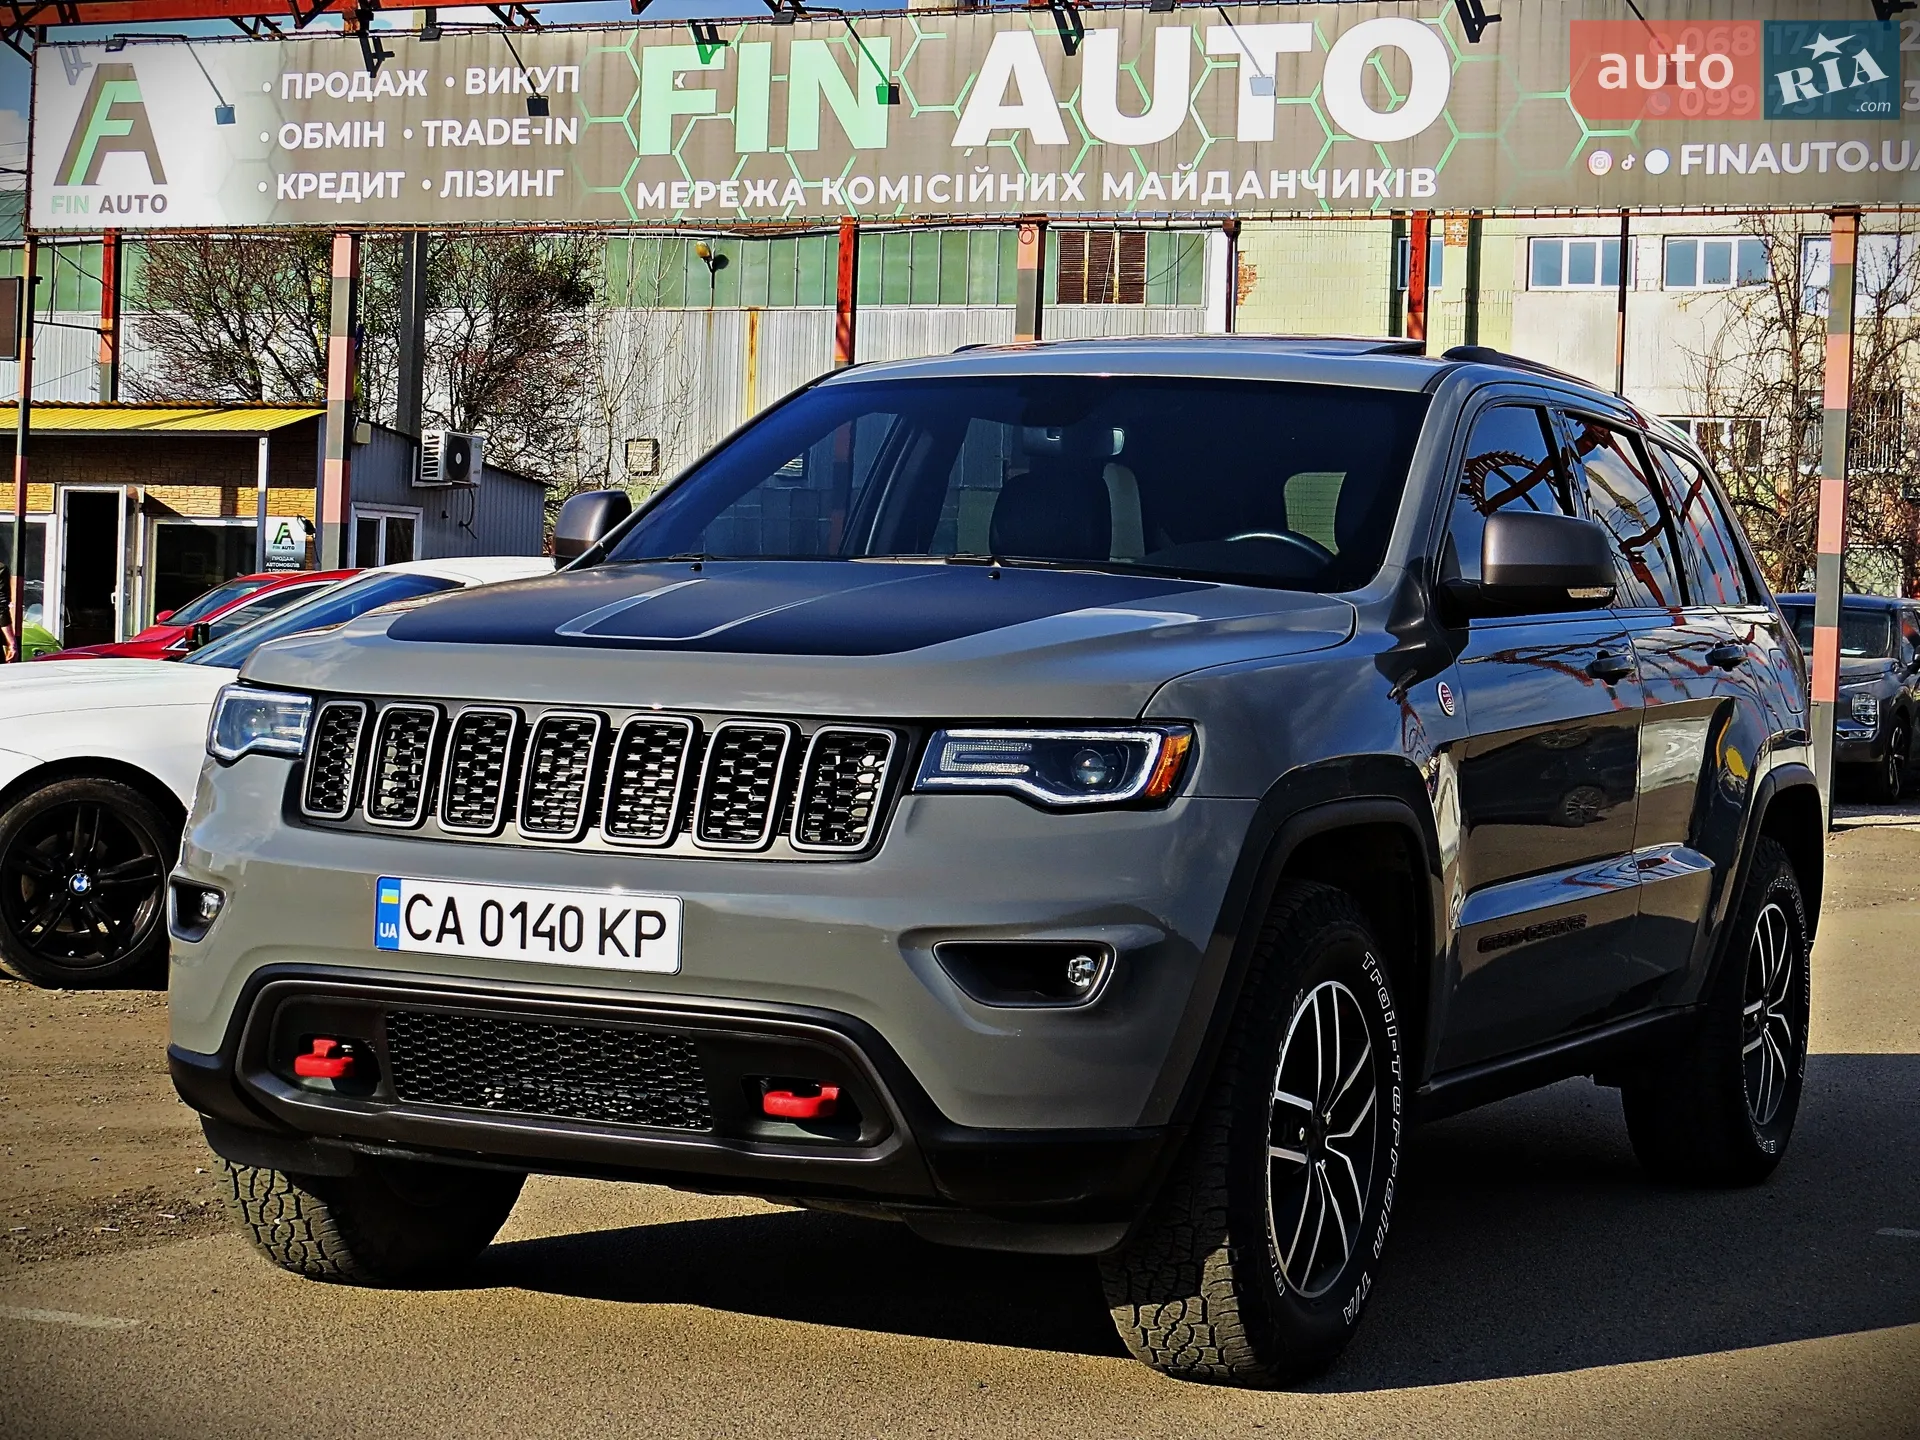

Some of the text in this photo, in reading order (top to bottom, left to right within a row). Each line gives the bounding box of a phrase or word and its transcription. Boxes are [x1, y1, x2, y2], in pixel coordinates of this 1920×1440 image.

[281, 69, 429, 103] ПРОДАЖ
[465, 65, 580, 95] ВИКУП
[639, 15, 1453, 156] FIN AUTO
[278, 121, 385, 150] ОБМІН
[421, 117, 578, 147] TRADE-IN
[277, 171, 406, 204] КРЕДИТ
[440, 169, 565, 198] ЛІЗИНГ
[637, 162, 1438, 210] МЕРЕЖА КОМІСІЙНИХ МАЙДАНЧИКІВ
[51, 193, 168, 214] FIN AUTO
[380, 922, 398, 939] UA
[404, 893, 667, 958] CA 0140 KP
